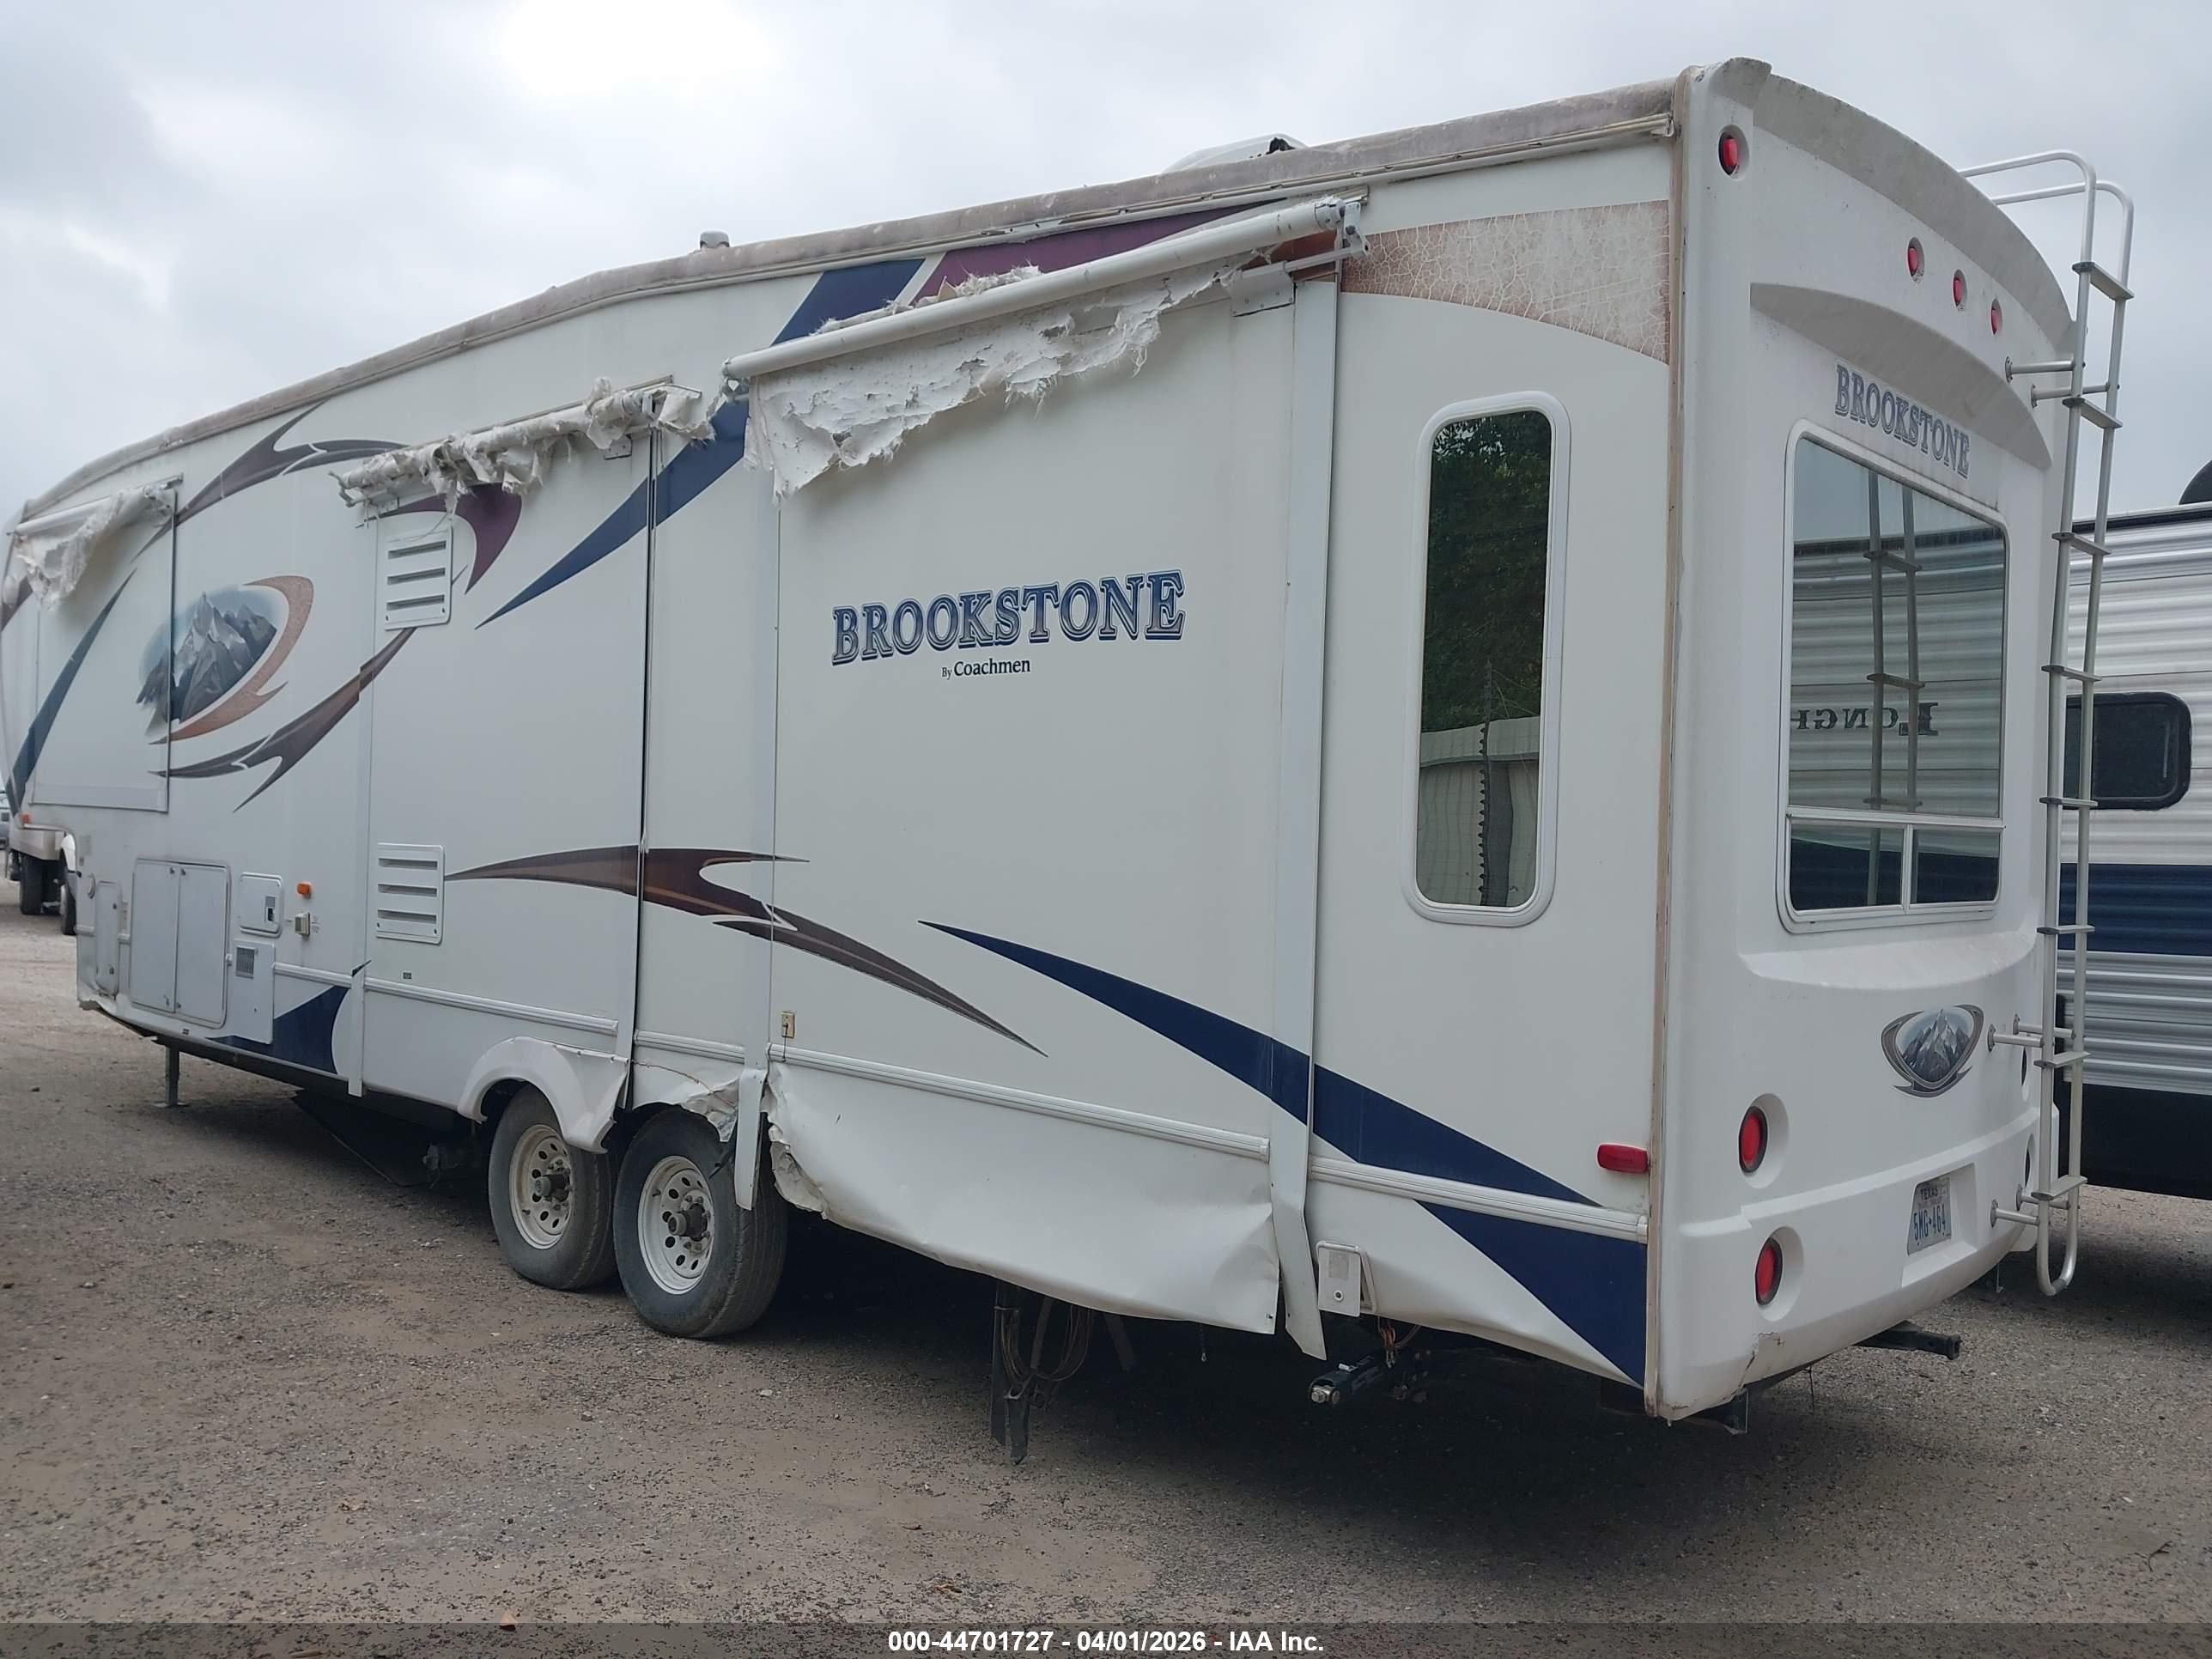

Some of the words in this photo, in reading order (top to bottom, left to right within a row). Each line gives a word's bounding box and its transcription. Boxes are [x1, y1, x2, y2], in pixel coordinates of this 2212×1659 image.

[1834, 363, 1971, 479] BROOKSTONE
[831, 568, 1185, 665] BROOKSTONE
[942, 666, 952, 680] By
[954, 658, 1030, 677] Coachmen
[1920, 1187, 1939, 1200] TEXAS
